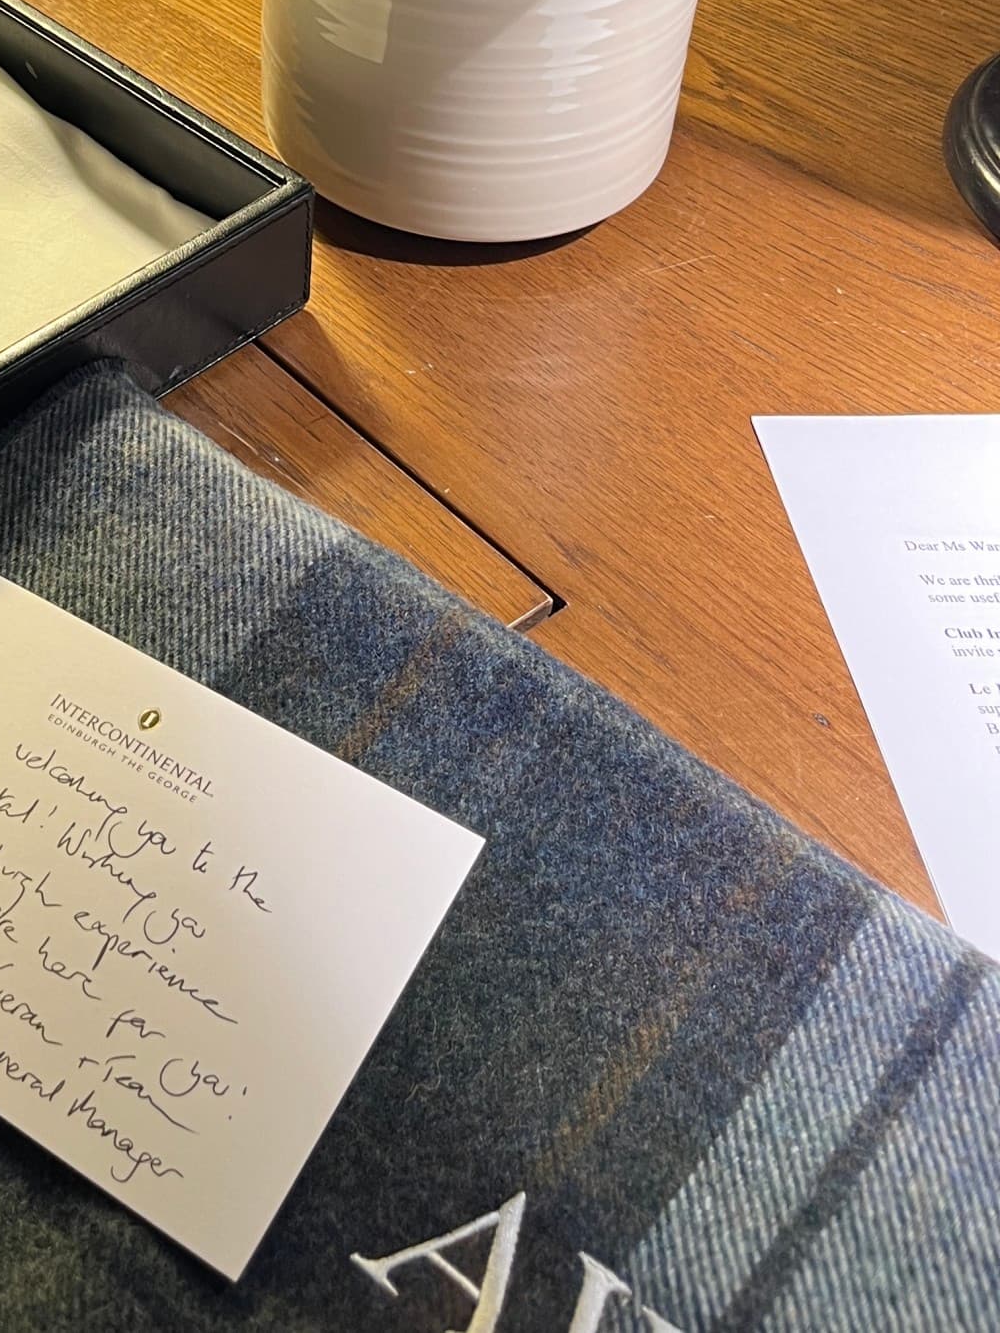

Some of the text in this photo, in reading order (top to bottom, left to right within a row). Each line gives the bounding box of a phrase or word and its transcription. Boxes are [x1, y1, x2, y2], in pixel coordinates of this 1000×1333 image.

[904, 540, 939, 552] Dear
[941, 540, 966, 552] Ms
[919, 574, 946, 586] We
[949, 577, 971, 586] are
[928, 594, 966, 603] some
[944, 627, 983, 639] Club
[951, 645, 995, 657] invite
[968, 683, 992, 695] Le
[47, 713, 198, 804] EDINBURGH THE GEORGE
[16, 742, 128, 842] welcoming
[192, 841, 215, 874] to
[229, 865, 273, 914] the
[57, 821, 157, 923] Wishing
[38, 936, 102, 1000] here
[106, 1009, 167, 1038] for
[74, 911, 239, 1024] experience
[67, 1090, 184, 1183] Manager
